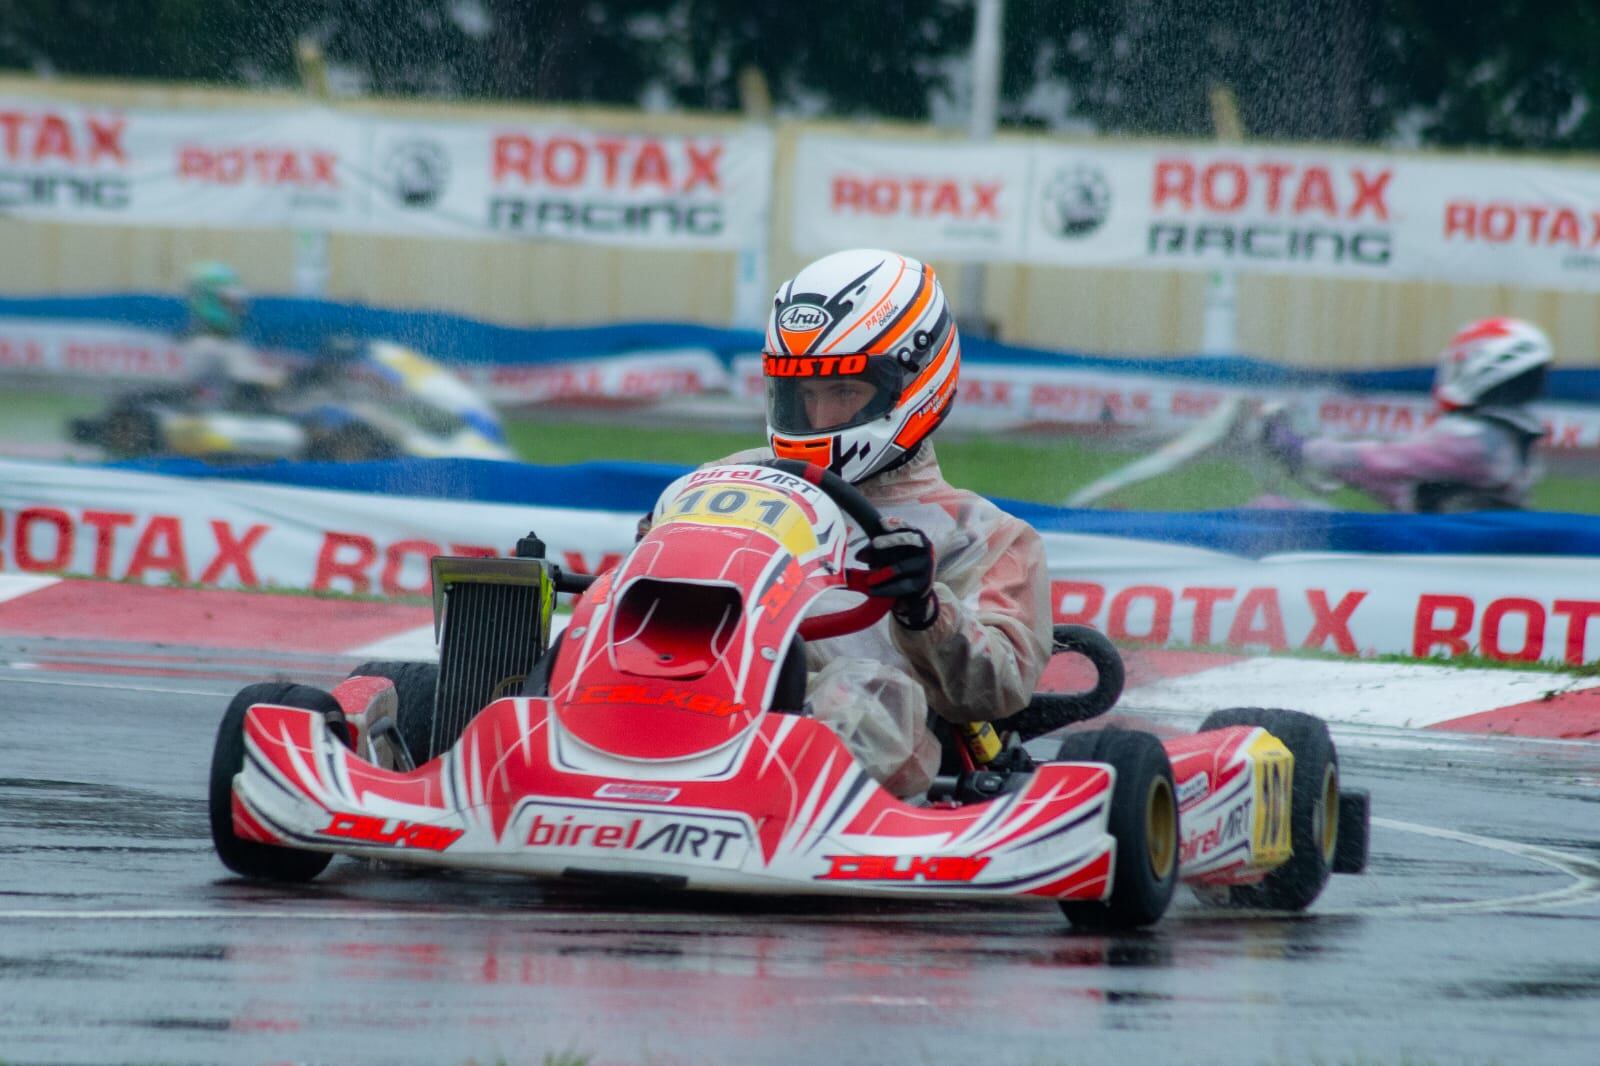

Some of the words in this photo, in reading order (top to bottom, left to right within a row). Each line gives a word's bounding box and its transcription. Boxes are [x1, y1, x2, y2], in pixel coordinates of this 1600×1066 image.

[178, 147, 337, 185] ROTAX
[493, 134, 722, 190] ROTAX
[831, 177, 1001, 218] ROTAX
[1153, 158, 1392, 219] ROTAX
[783, 308, 823, 326] Arai
[676, 489, 788, 527] 101
[0, 507, 271, 586] OTAX
[527, 814, 742, 861] birelART
